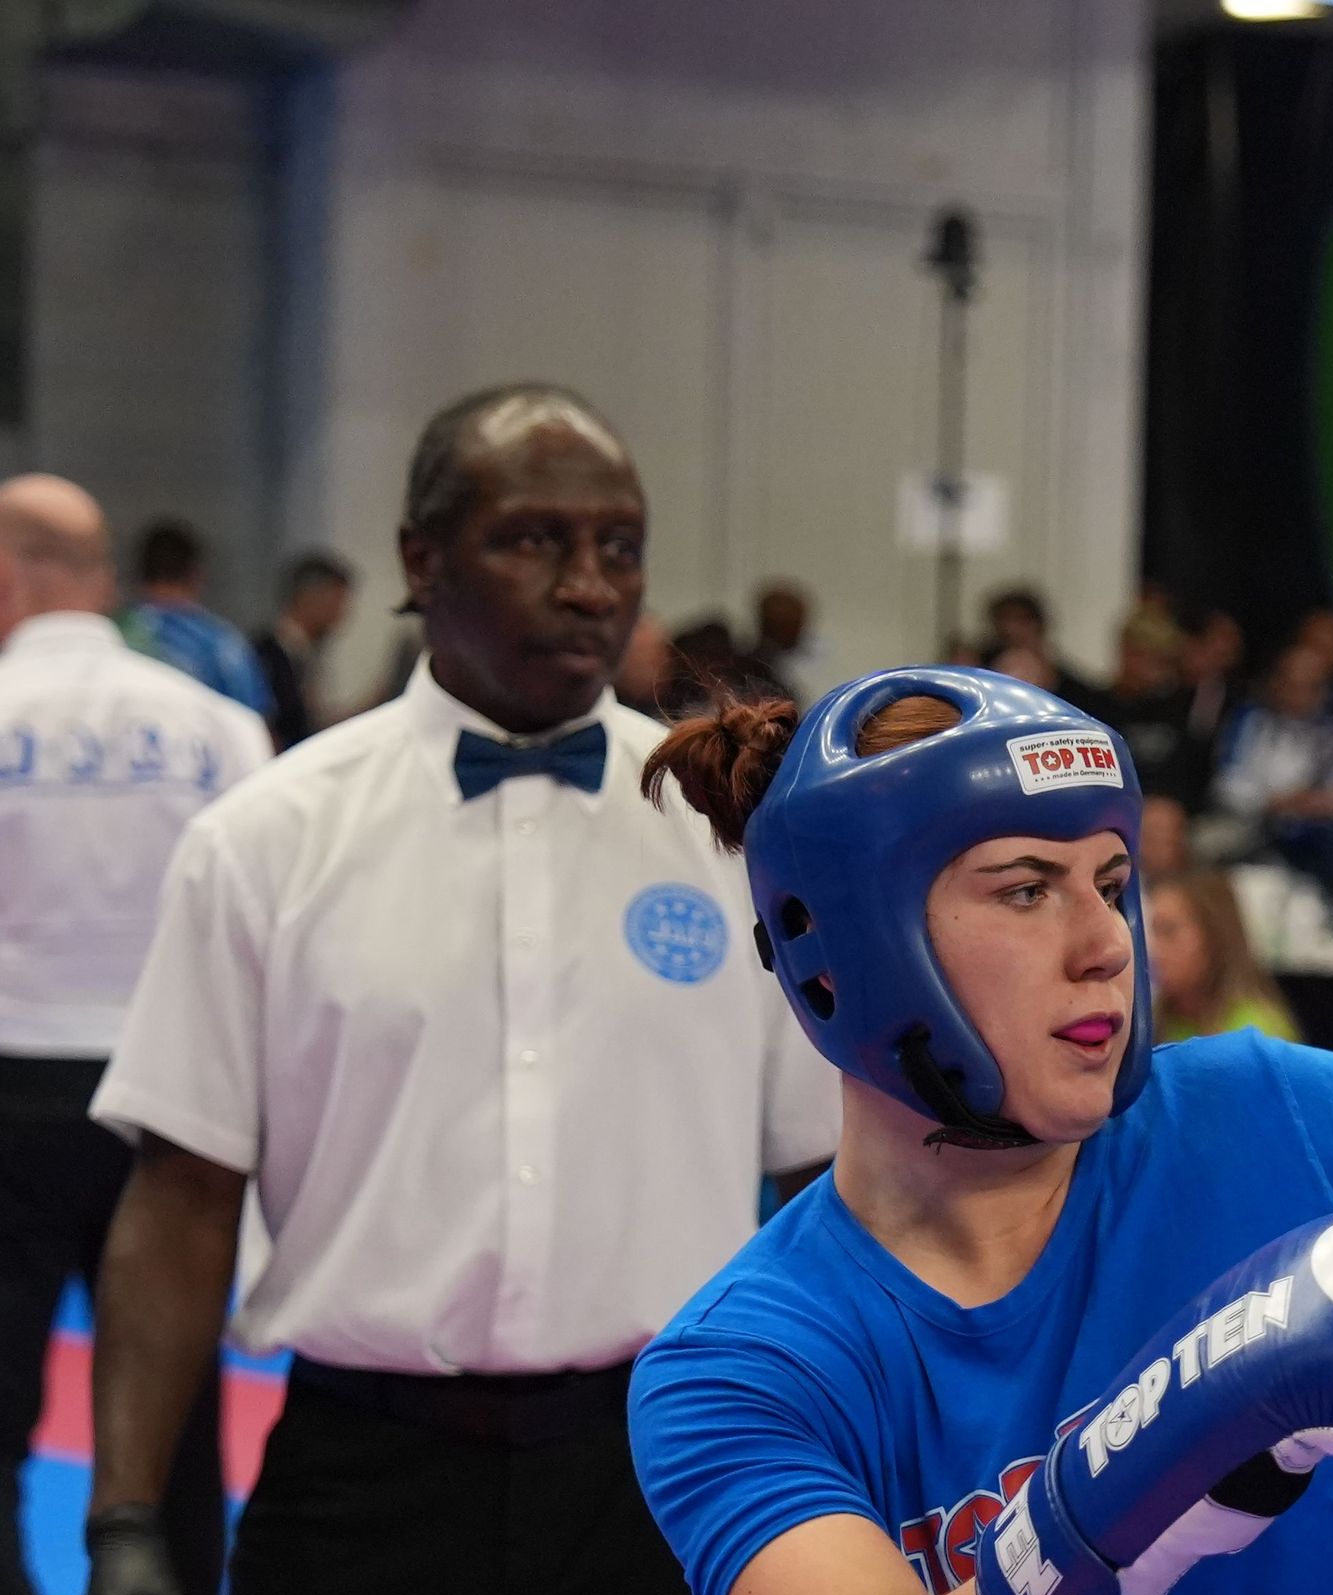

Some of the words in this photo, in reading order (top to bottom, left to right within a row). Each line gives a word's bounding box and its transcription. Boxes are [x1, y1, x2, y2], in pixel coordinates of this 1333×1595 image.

[1075, 738, 1108, 746] equipment
[1022, 748, 1074, 776] TOP
[1076, 746, 1116, 769] TEN
[1052, 771, 1071, 779] made
[1073, 769, 1079, 777] in
[1079, 769, 1105, 777] Germany
[1079, 1357, 1171, 1478] TOP
[1172, 1275, 1294, 1389] TEN
